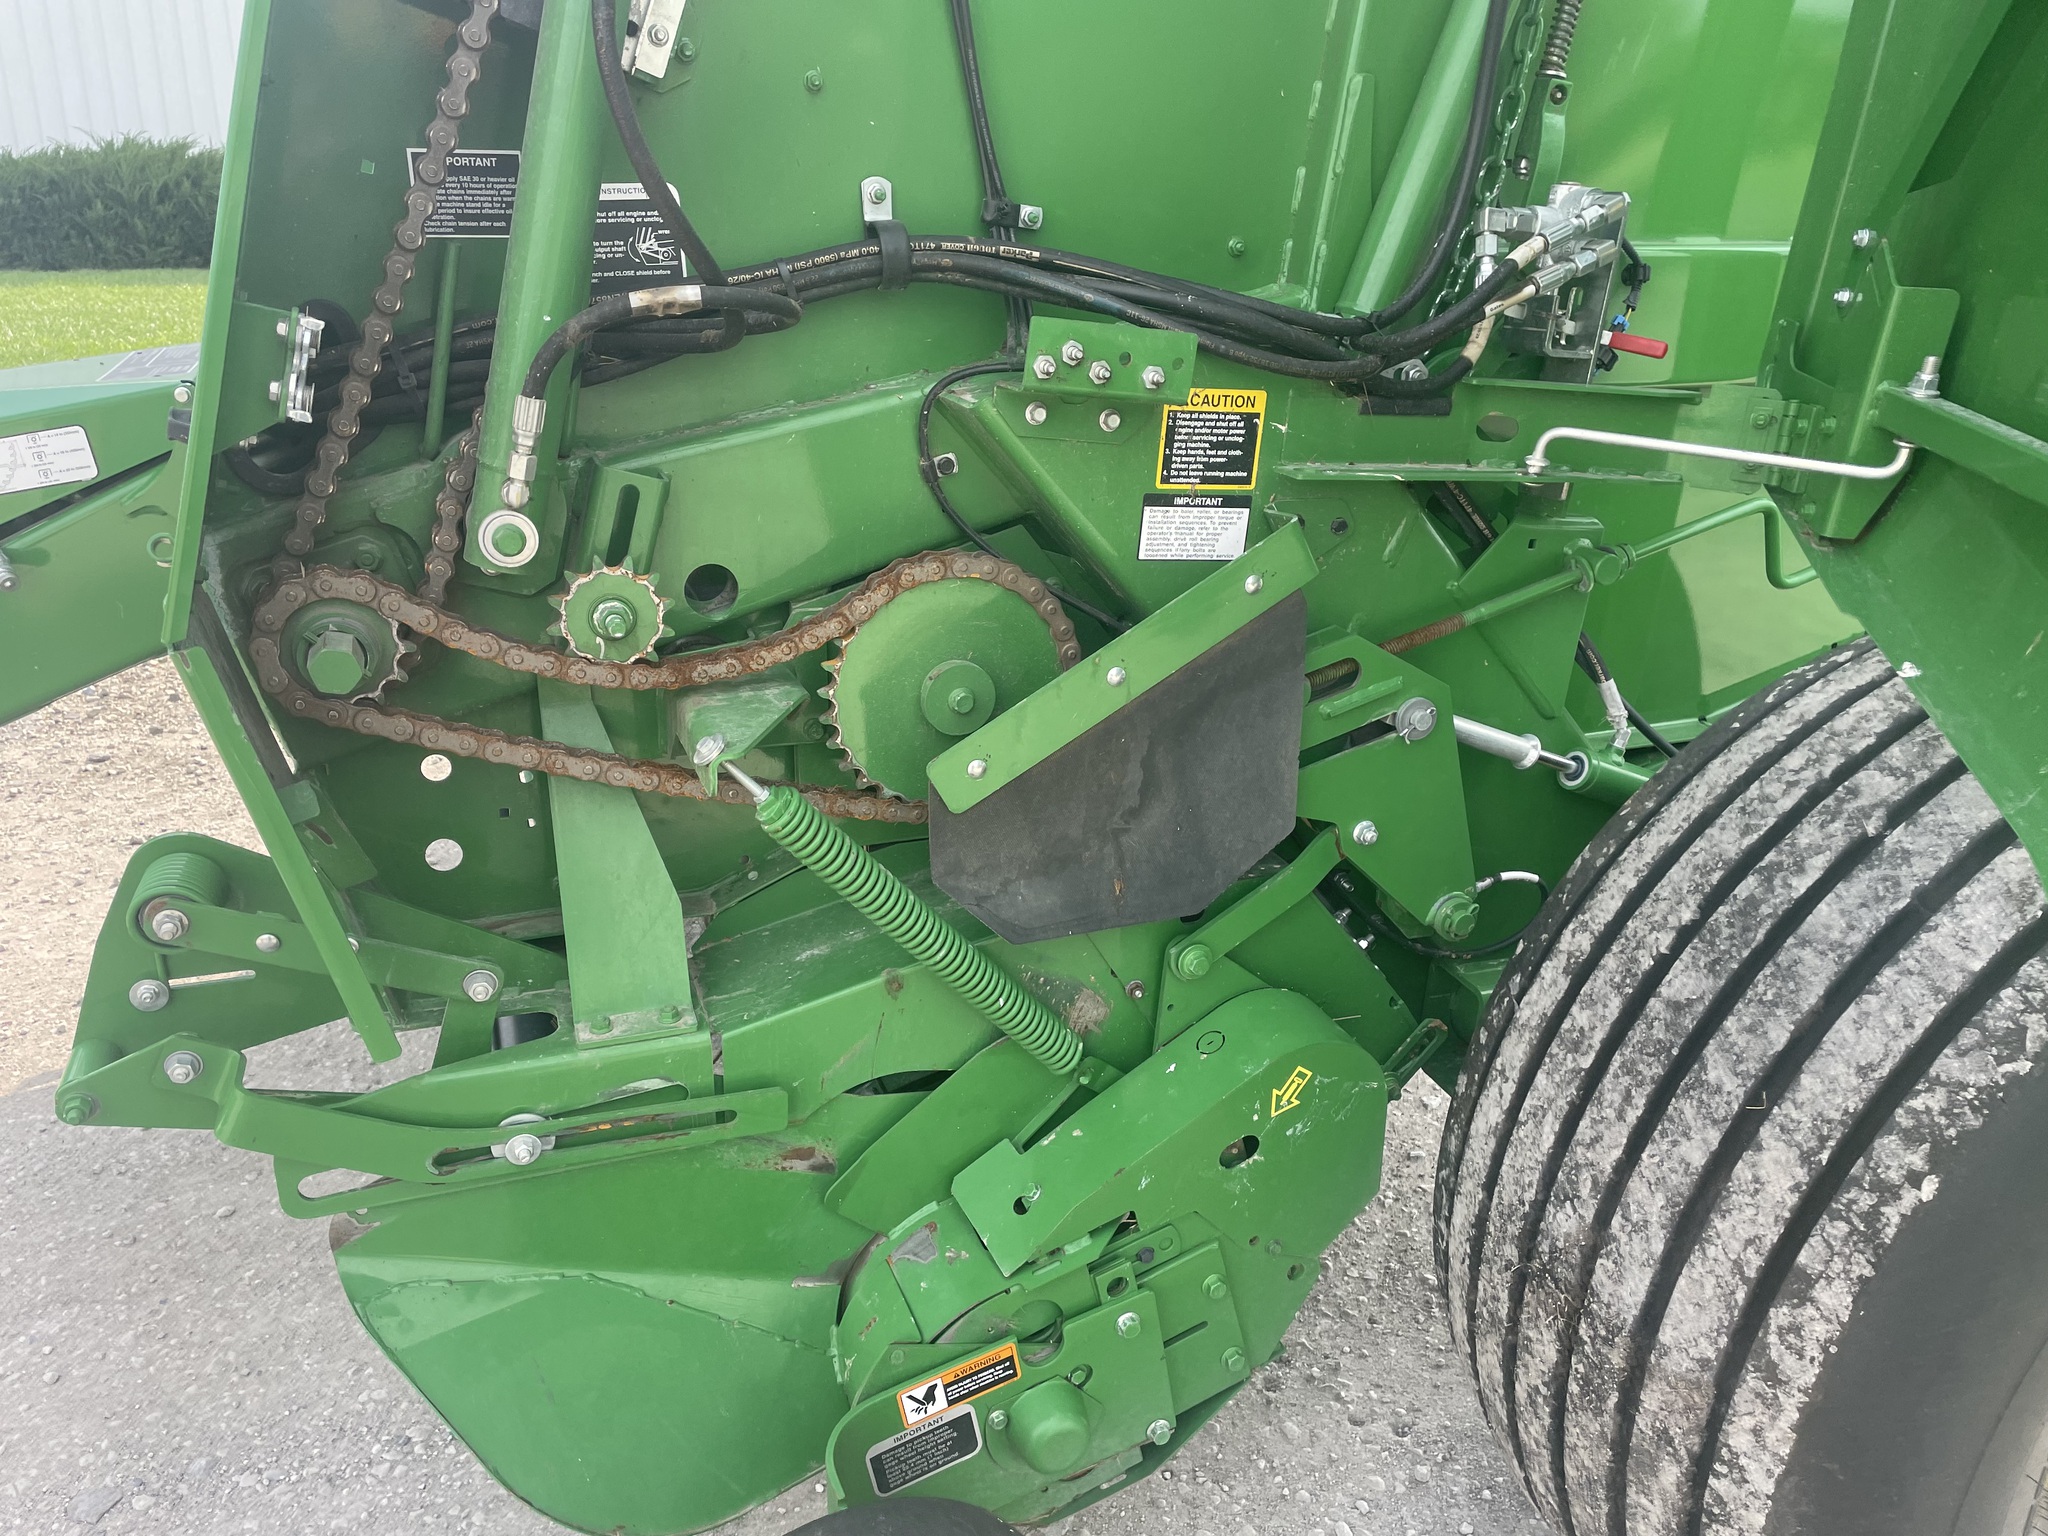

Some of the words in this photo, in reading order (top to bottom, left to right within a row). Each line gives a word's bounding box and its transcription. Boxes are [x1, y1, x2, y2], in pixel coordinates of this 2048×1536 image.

[445, 156, 497, 167] PORTANT
[861, 245, 880, 254] 40,0
[940, 242, 966, 251] COVER
[814, 252, 838, 265] (5800
[839, 248, 859, 259] MPa
[1001, 247, 1033, 260] Parker
[794, 258, 813, 271] PSI)
[727, 270, 763, 285] IC-40/26
[1190, 393, 1256, 408] CAUTION
[1174, 497, 1224, 506] IMPORTANT
[960, 1354, 1001, 1375] WARNING
[893, 1415, 944, 1444] IMPORTANT
[928, 1429, 953, 1443] improper
[881, 1446, 905, 1459] Damage
[913, 1433, 934, 1445] pickup
